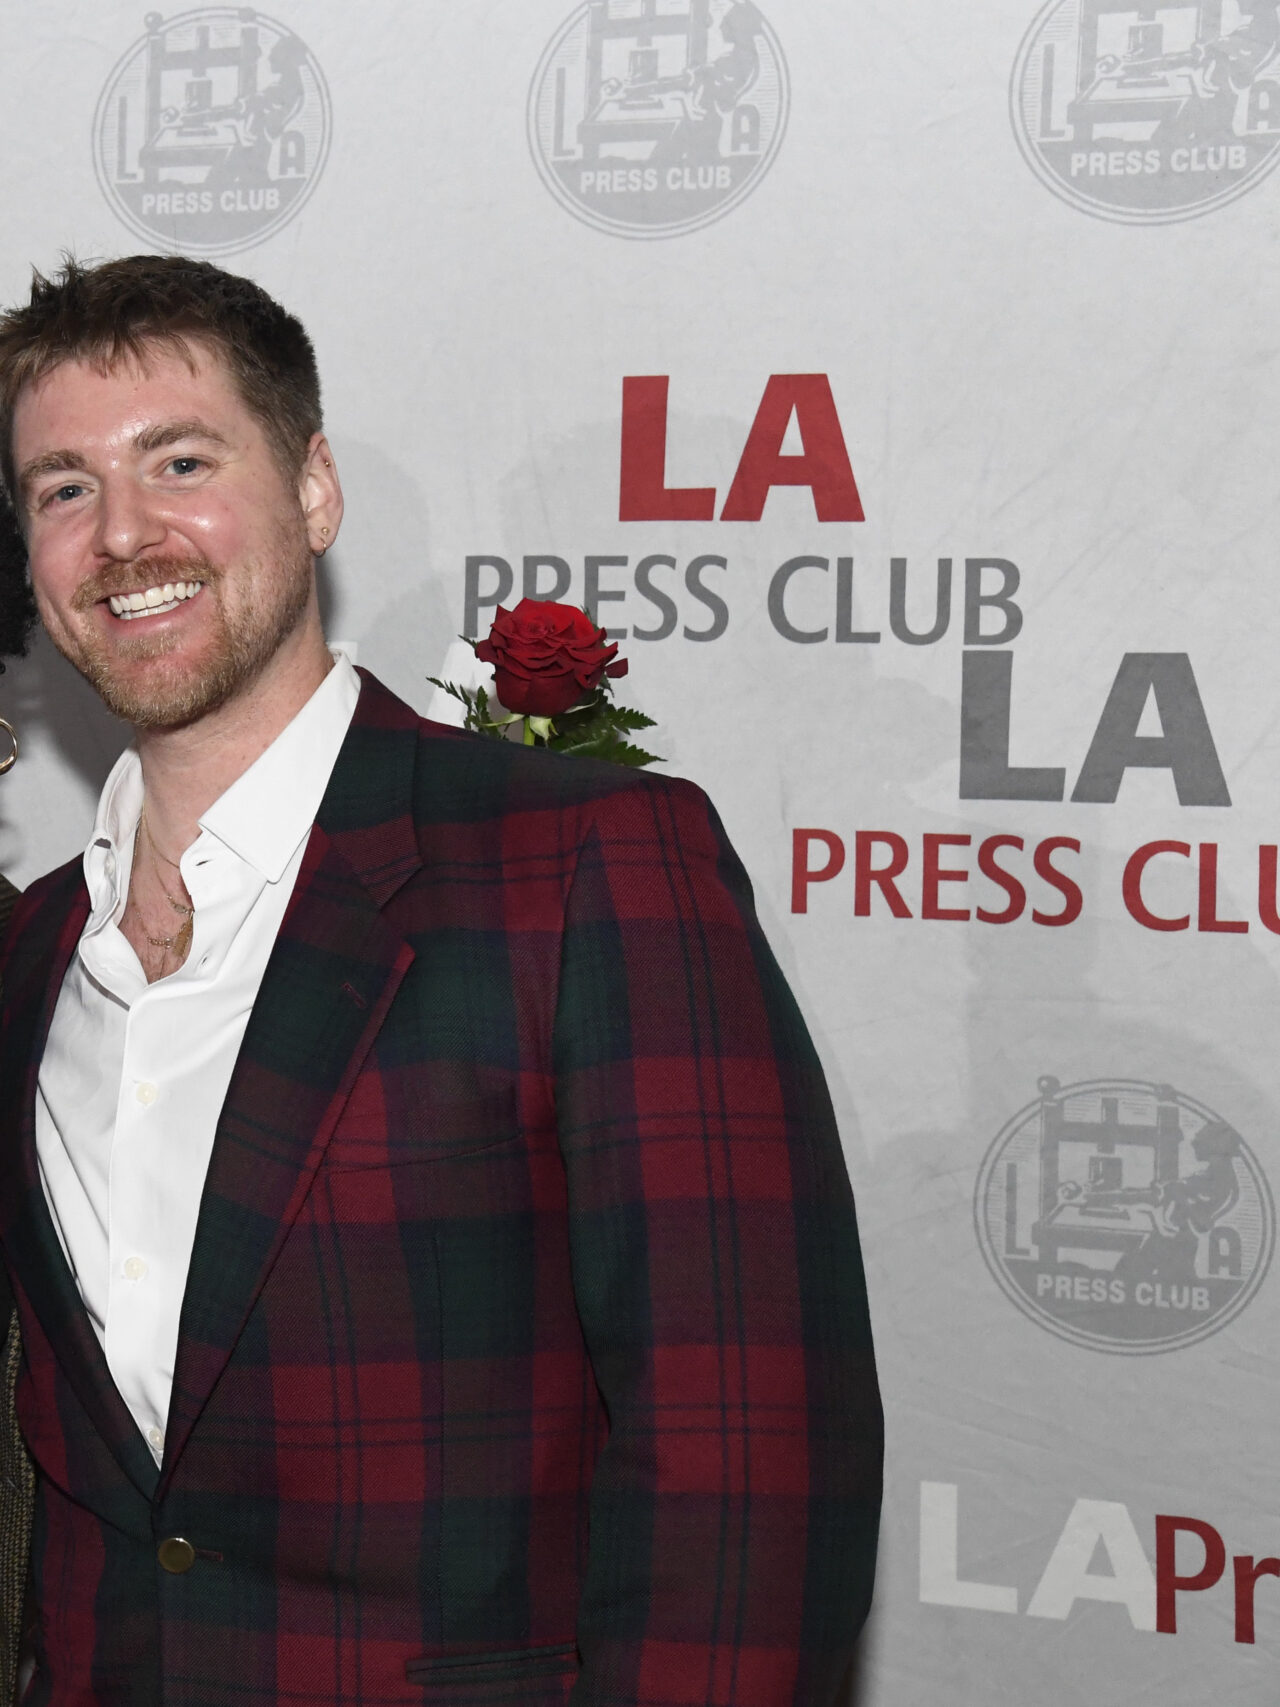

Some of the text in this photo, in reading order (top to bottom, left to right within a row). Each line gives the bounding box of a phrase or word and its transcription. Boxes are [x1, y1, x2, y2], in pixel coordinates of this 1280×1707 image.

[142, 188, 280, 215] PRESS CLUB
[580, 166, 731, 194] PRESS CLUB
[1071, 146, 1247, 177] PRESS CLUB
[619, 374, 865, 522] LA
[768, 557, 1023, 646] CLUB
[959, 651, 1232, 807] LA
[791, 828, 1083, 926] PRESS
[1037, 1274, 1211, 1311] PRESS CLUB
[921, 1481, 1157, 1632] LA
